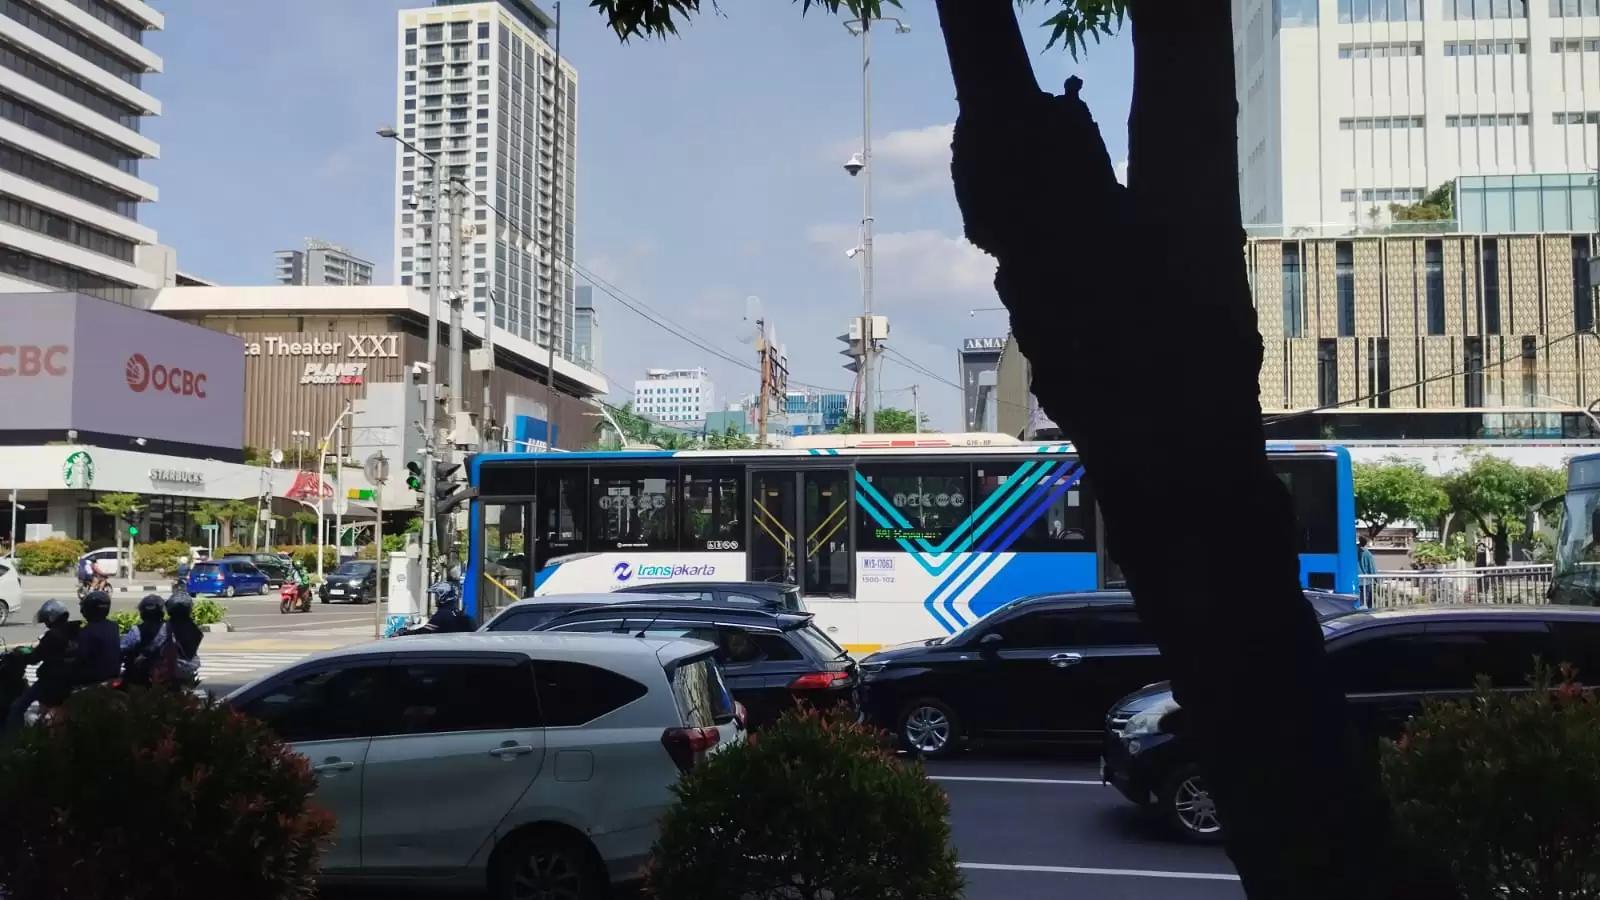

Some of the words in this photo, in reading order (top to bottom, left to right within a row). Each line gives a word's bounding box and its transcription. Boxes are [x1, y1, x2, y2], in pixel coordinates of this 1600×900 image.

[264, 336, 342, 355] Theater
[347, 335, 399, 357] XXI
[304, 362, 367, 376] PLANET
[152, 364, 207, 399] OCBC
[149, 468, 206, 483] STARBUCKS
[638, 563, 715, 578] transjakarta
